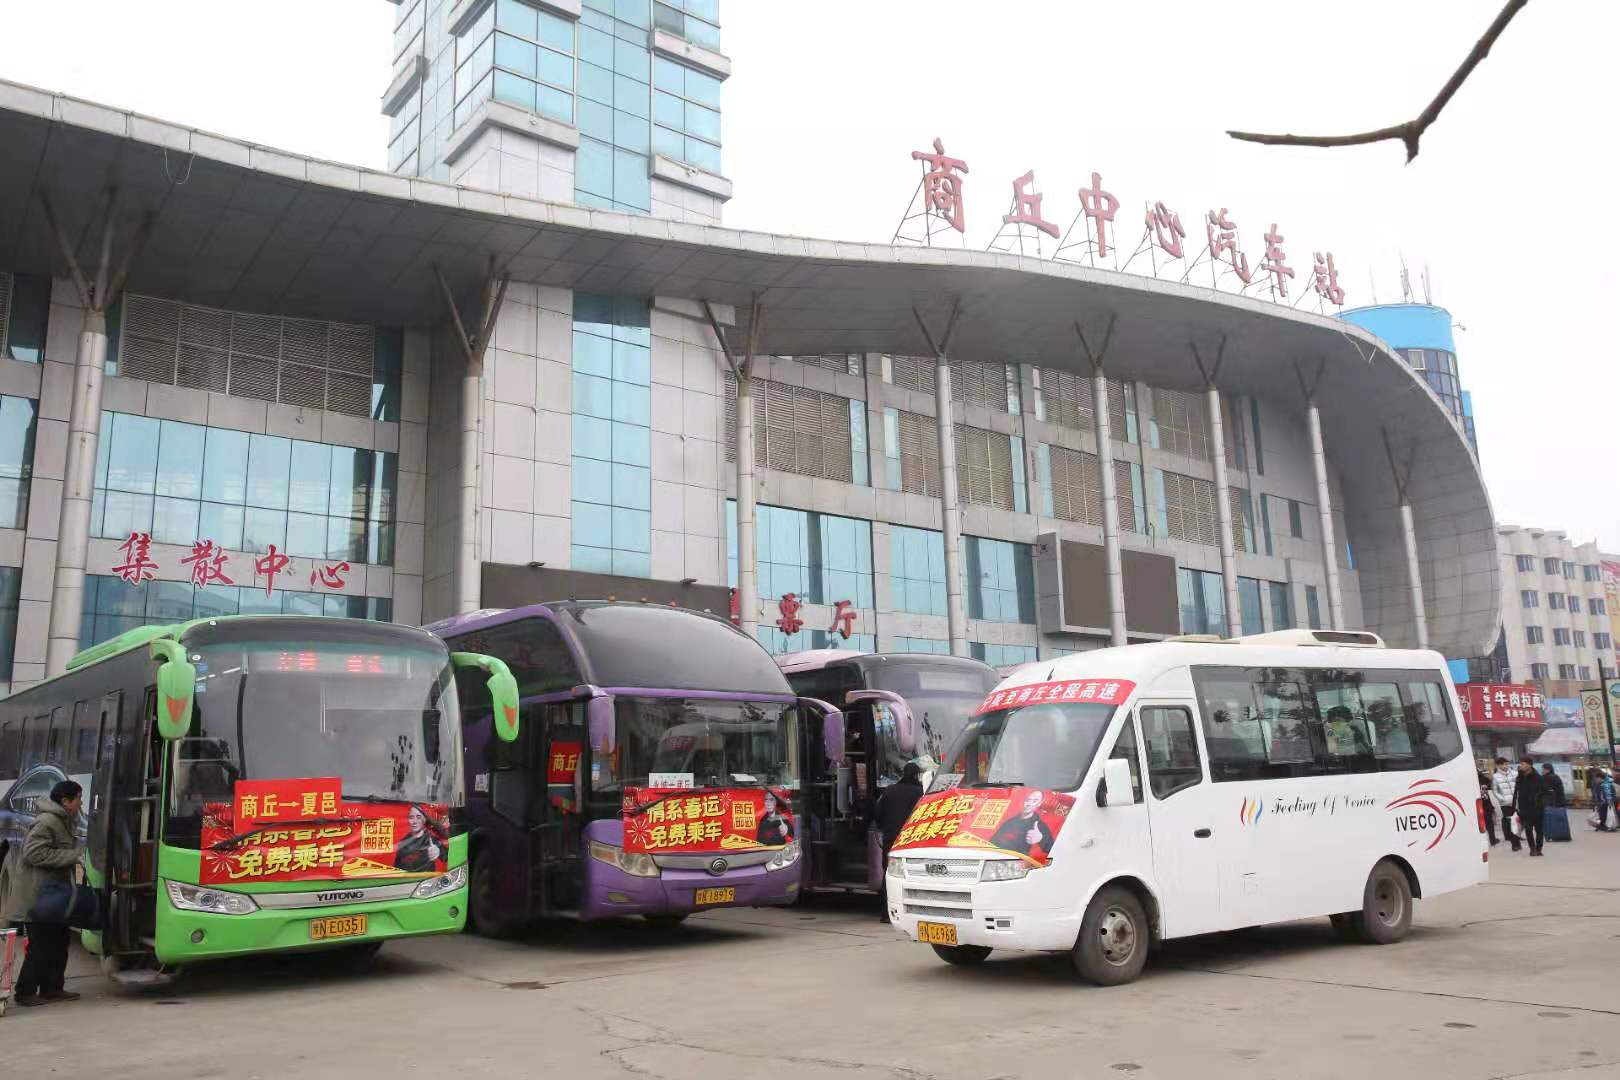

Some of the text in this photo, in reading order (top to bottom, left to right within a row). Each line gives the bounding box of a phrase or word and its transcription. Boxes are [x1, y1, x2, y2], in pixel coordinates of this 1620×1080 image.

[911, 137, 1346, 305] 商丘中心汽车站
[112, 532, 351, 598] 集散中心
[1494, 690, 1541, 708] 牛肉拉面
[553, 752, 577, 772] 商丘
[647, 795, 726, 824] 情系春运
[1271, 797, 1317, 816] Feeling
[364, 821, 392, 836] 商丘
[1395, 813, 1438, 832] IVECO
[364, 836, 392, 851] 邮政
[645, 820, 723, 850] 免费乘车
[230, 842, 345, 879] 免费乘车
[316, 890, 364, 902] YUTONG
